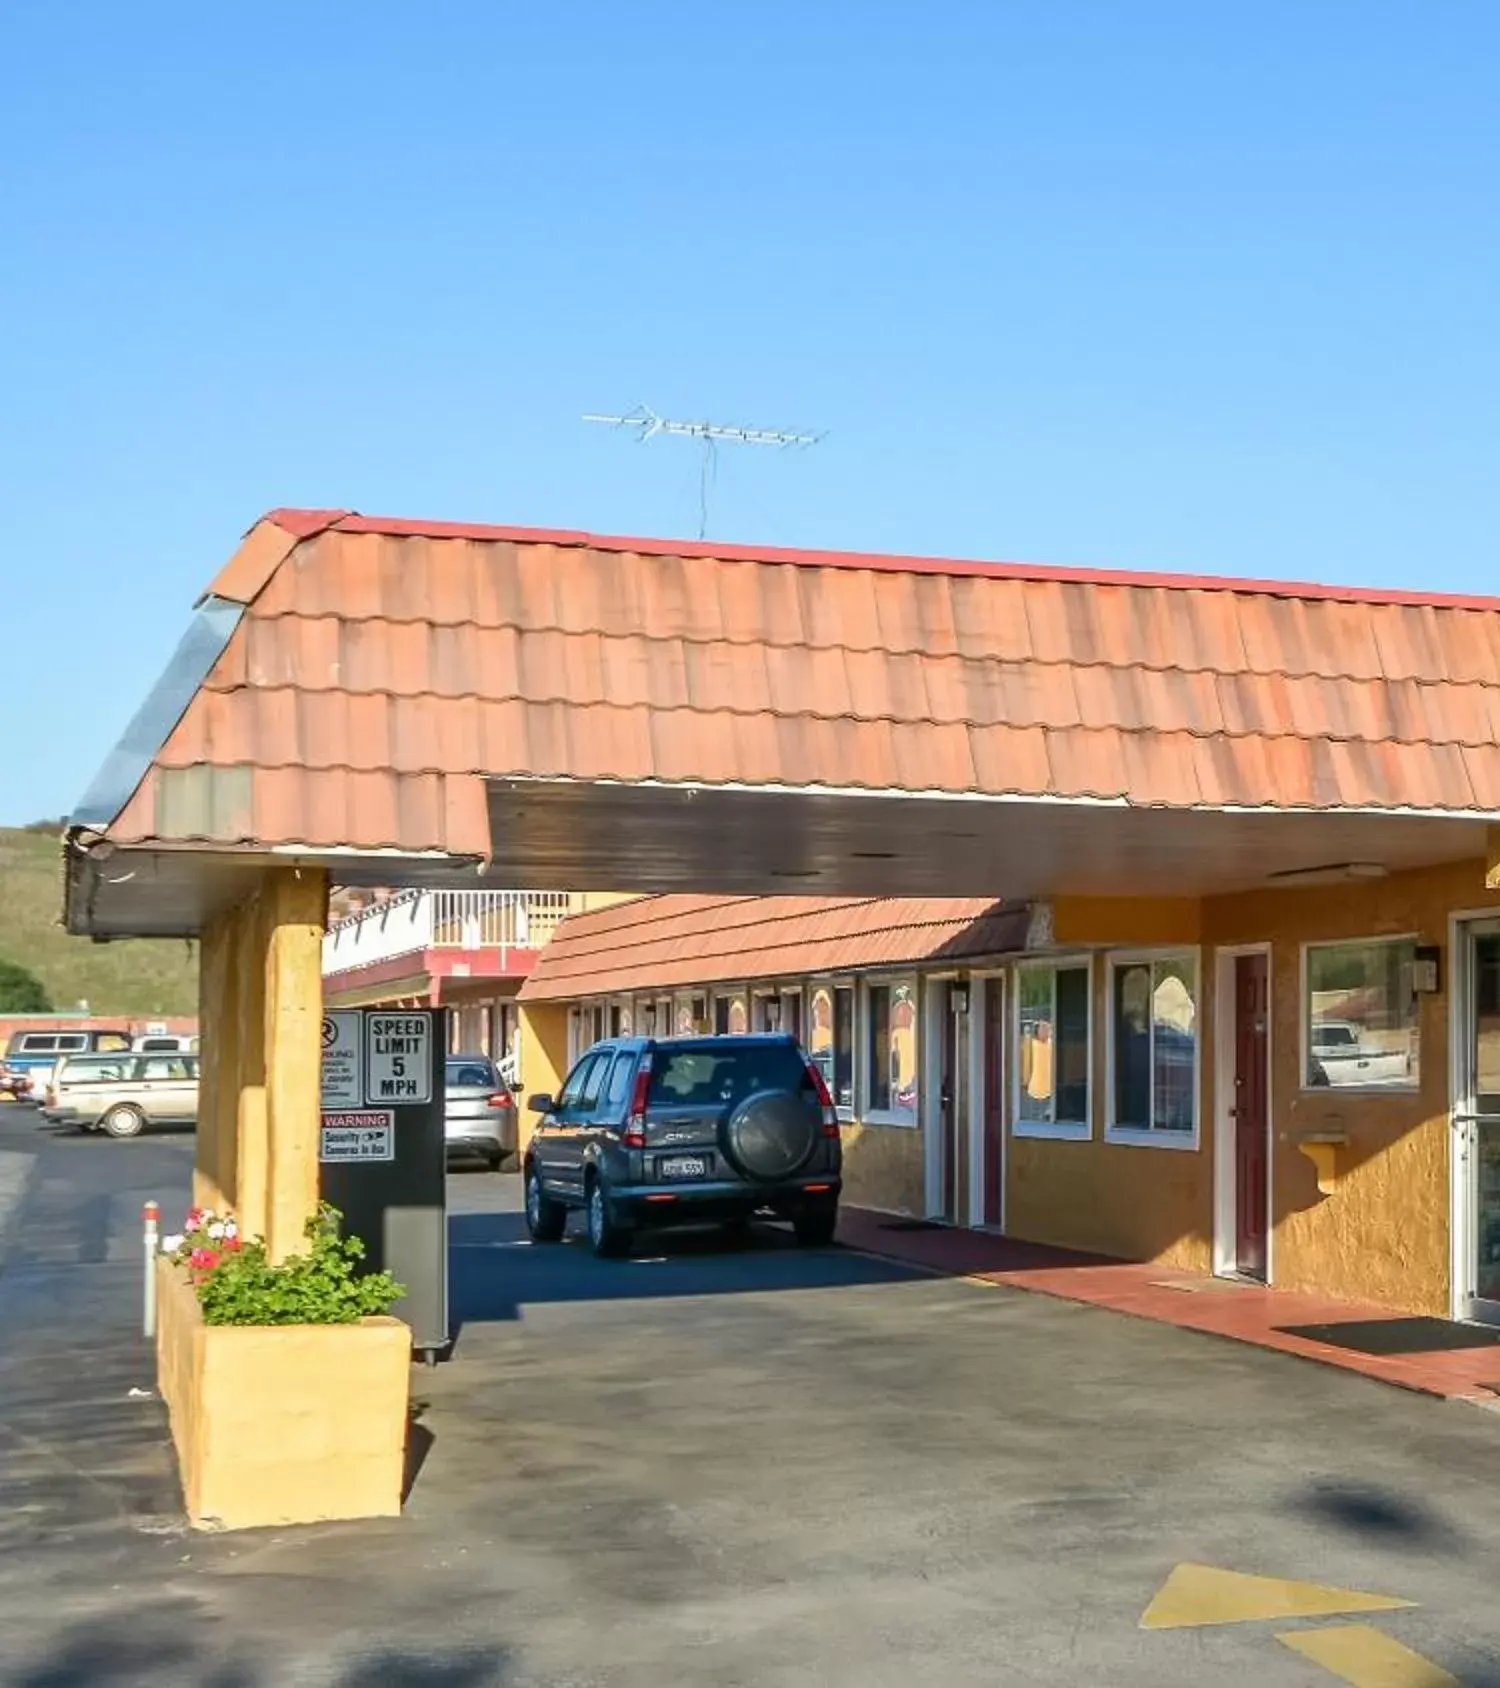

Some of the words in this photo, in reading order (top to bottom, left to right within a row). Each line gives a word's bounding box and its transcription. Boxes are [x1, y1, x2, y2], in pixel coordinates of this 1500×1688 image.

[373, 1020, 424, 1035] SPEED
[376, 1038, 421, 1054] LIMIT
[392, 1057, 404, 1076] 5
[381, 1080, 417, 1096] MPH
[325, 1115, 387, 1126] WARNING
